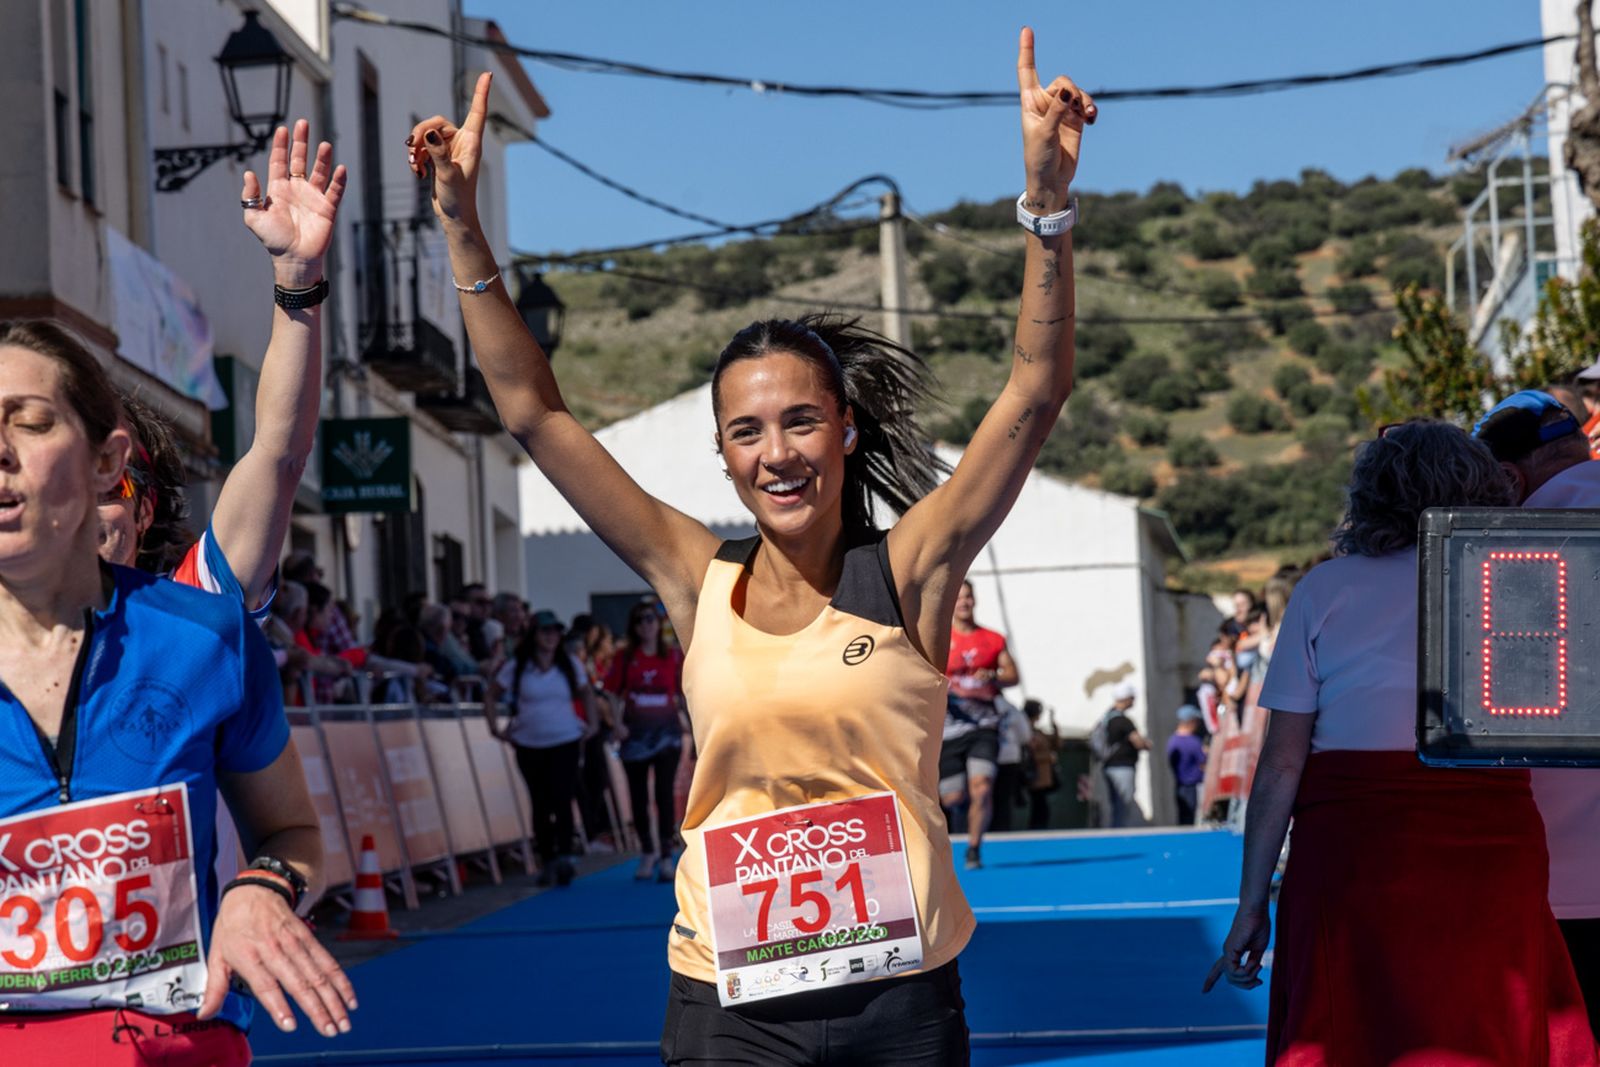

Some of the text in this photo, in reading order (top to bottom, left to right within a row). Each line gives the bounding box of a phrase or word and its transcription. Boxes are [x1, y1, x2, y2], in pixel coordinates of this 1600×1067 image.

[1482, 551, 1567, 716] 0
[24, 819, 151, 868] CROSS
[129, 856, 154, 872] DEL
[731, 818, 867, 865] X CROSS
[735, 847, 870, 887] PANTANO DEL
[0, 874, 160, 969] 305
[742, 862, 870, 943] 751
[746, 940, 793, 962] MAYTE
